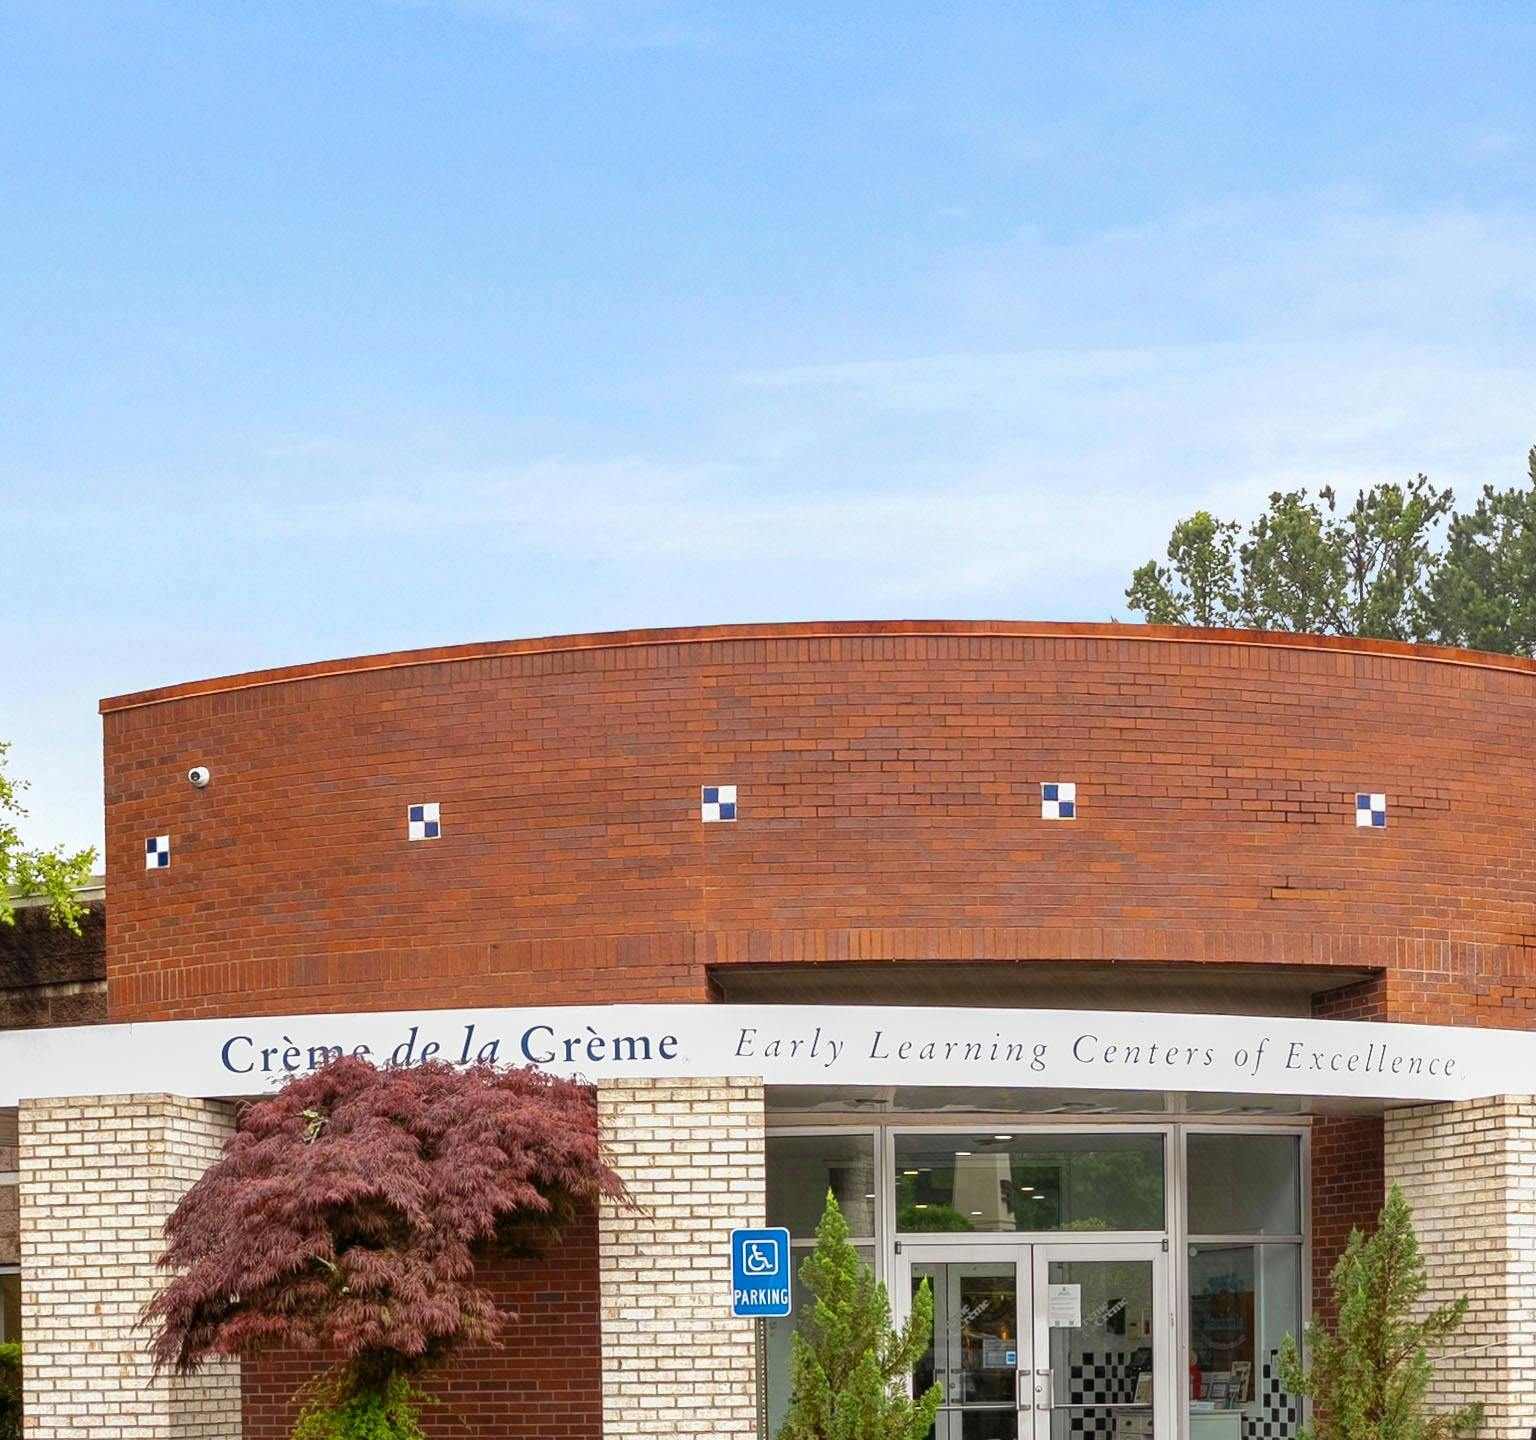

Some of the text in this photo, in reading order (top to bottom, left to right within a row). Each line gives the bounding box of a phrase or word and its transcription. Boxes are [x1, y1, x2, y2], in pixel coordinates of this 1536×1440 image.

[391, 1025, 441, 1068] de
[459, 1023, 501, 1066] la
[520, 1025, 678, 1064] Crème
[734, 1027, 1457, 1077] Early Learning Centers of Excellence
[733, 1288, 789, 1306] PARKING
